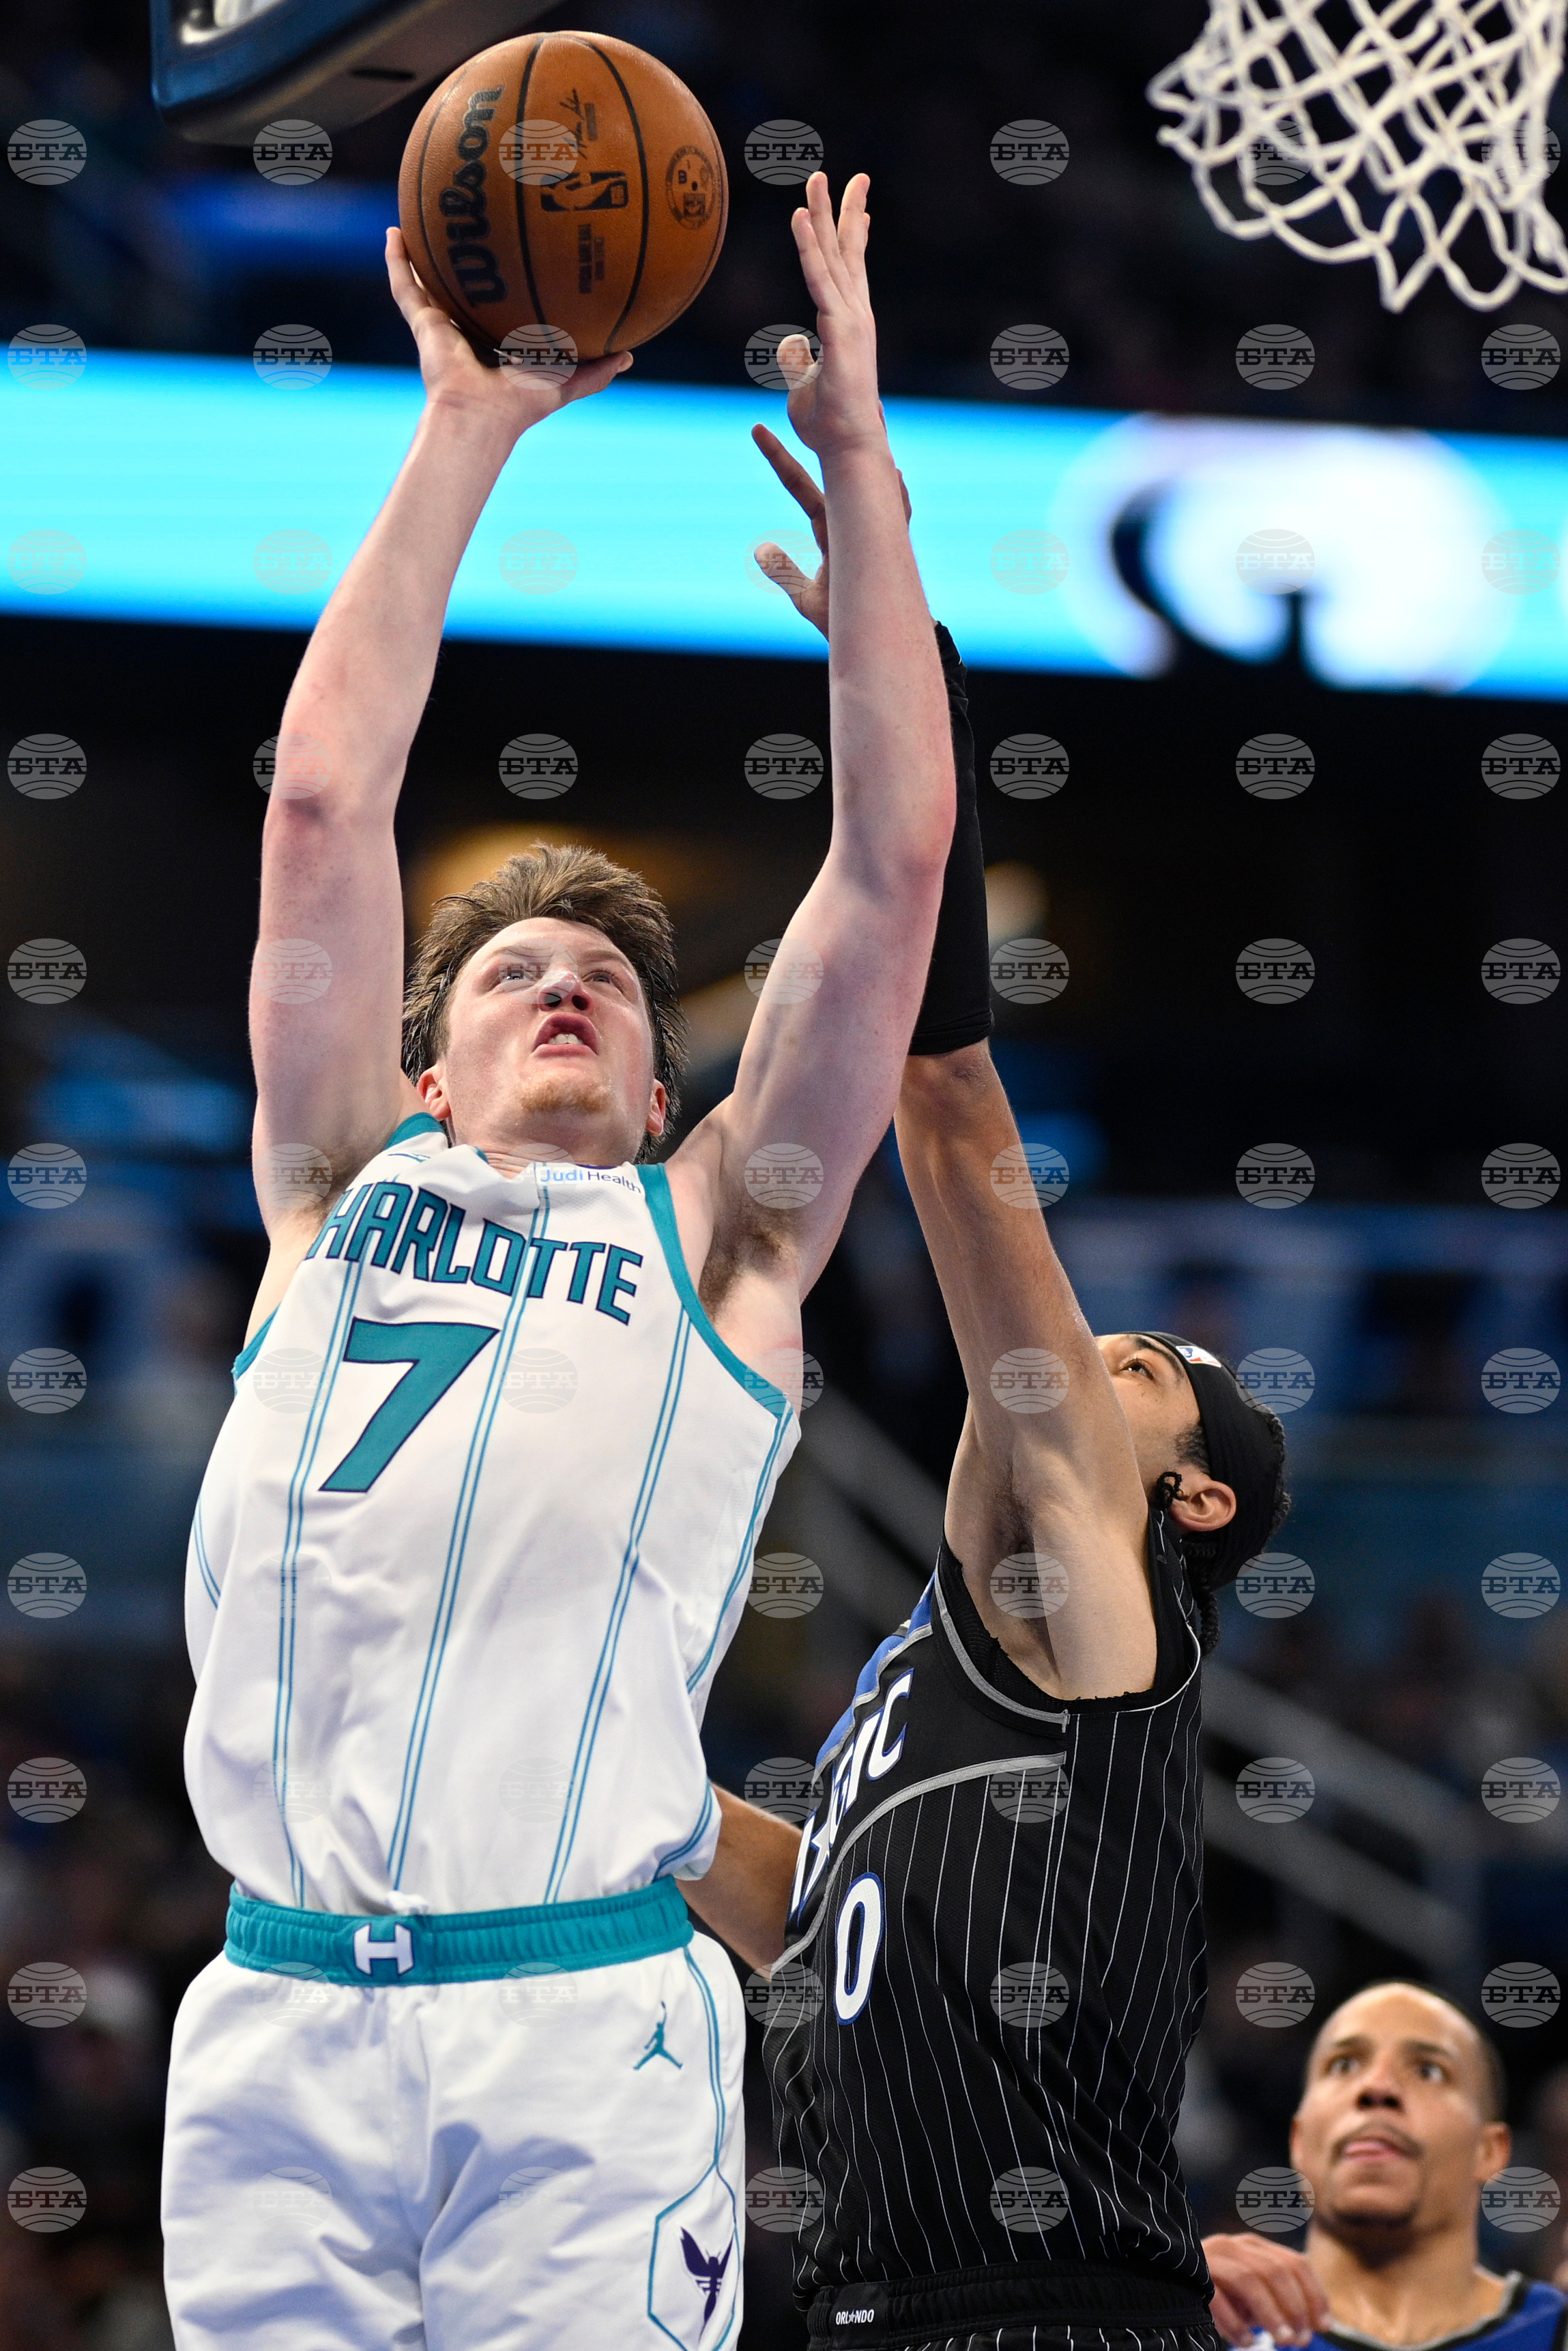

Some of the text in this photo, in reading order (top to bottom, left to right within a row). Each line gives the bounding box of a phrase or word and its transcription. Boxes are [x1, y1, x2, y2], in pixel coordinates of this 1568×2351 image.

[439, 85, 505, 307] Wilson
[540, 1162, 584, 1182] Judi
[587, 1164, 641, 1194] Health
[304, 1181, 643, 1326] HARLOTTE
[318, 1316, 500, 1492] 7
[353, 1922, 414, 1976] H
[834, 1872, 885, 2025] 0
